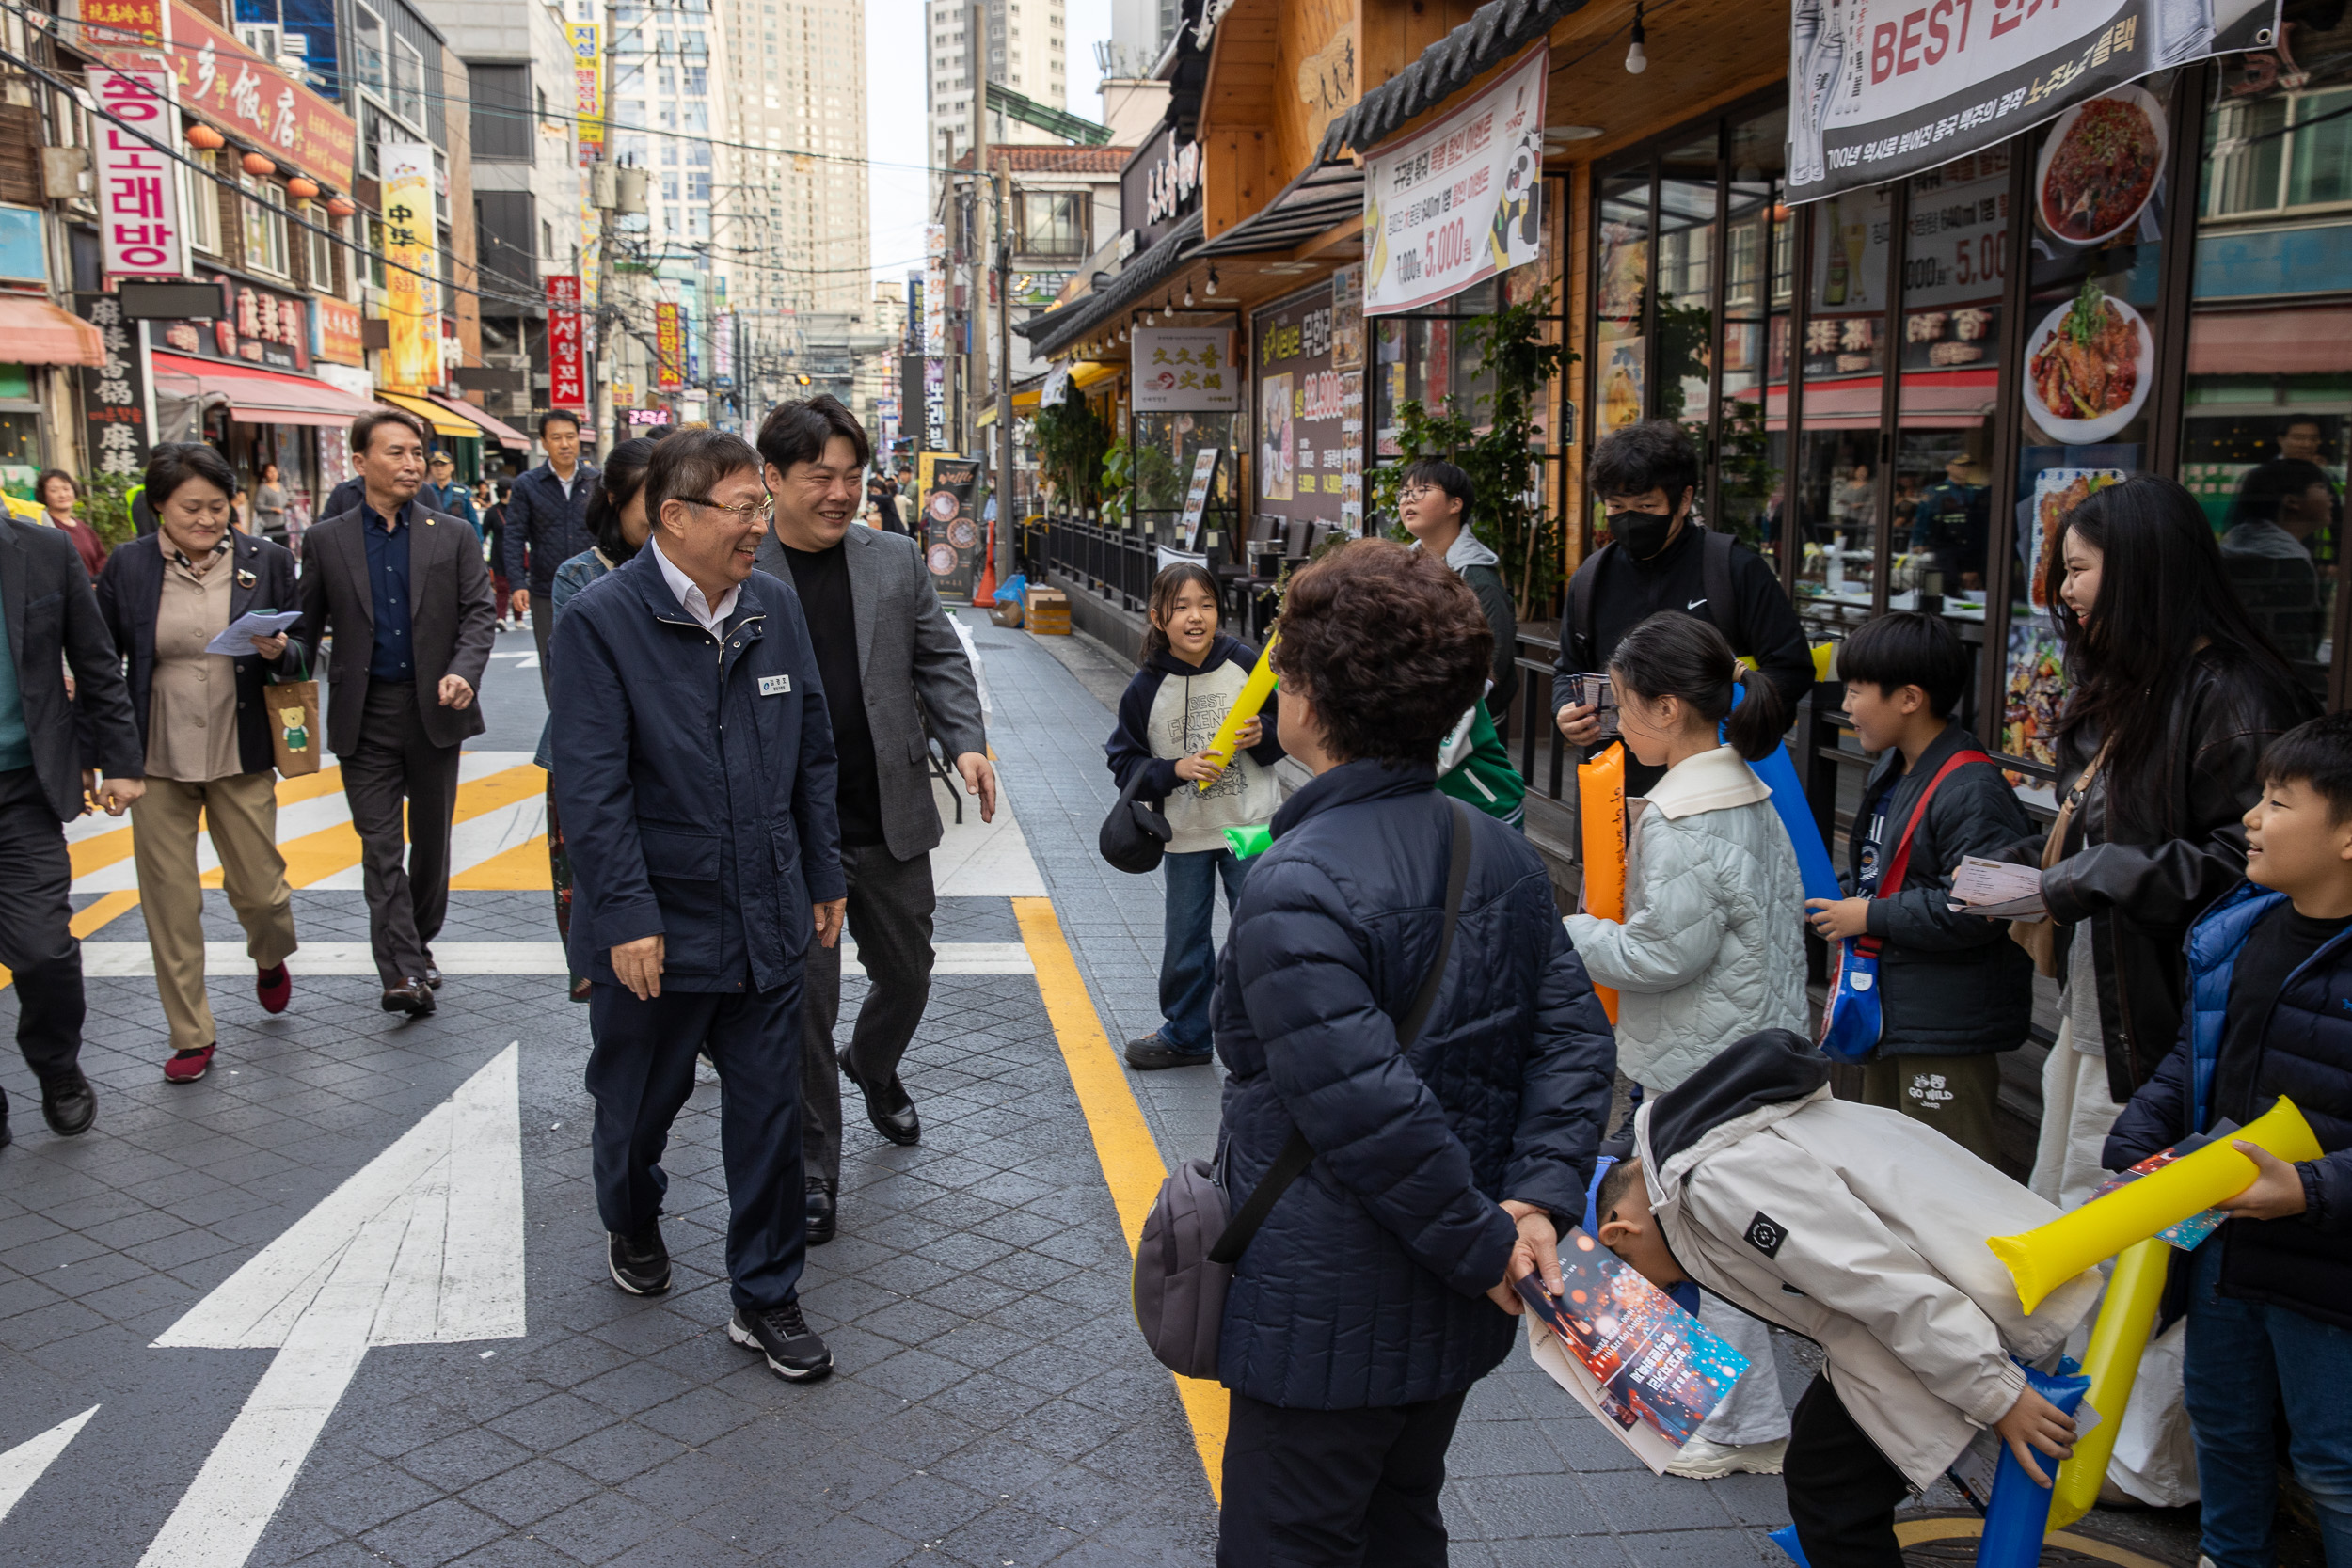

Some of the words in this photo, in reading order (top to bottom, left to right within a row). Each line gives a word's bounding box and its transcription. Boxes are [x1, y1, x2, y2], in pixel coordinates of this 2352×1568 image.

[1871, 0, 1973, 86] BEST
[575, 71, 598, 115] 행정사
[1448, 130, 1465, 166] 할인
[1466, 112, 1493, 154] 이벤트
[1827, 144, 1859, 170] 100년
[1863, 136, 1899, 163] 역사로
[1898, 124, 1933, 154] 빚어진
[1932, 113, 1959, 142] 중국
[1958, 99, 1997, 131] 백주의
[1995, 87, 2026, 119] 걸작
[1453, 178, 1467, 208] 할인
[1468, 166, 1490, 199] 이벤트
[1425, 216, 1471, 277] 5,000원
[1152, 343, 1222, 369] 久久香
[1188, 693, 1227, 711] BEST
[1908, 1086, 1924, 1100] GO
[1925, 1087, 1954, 1101] WILD
[1920, 1100, 1941, 1110] Jeep
[1618, 1330, 1629, 1341] 10월
[1621, 1308, 1634, 1323] 16:00
[1630, 1333, 1676, 1384] 음식문화축제
[1647, 1347, 1687, 1391] 양꼬치거리
